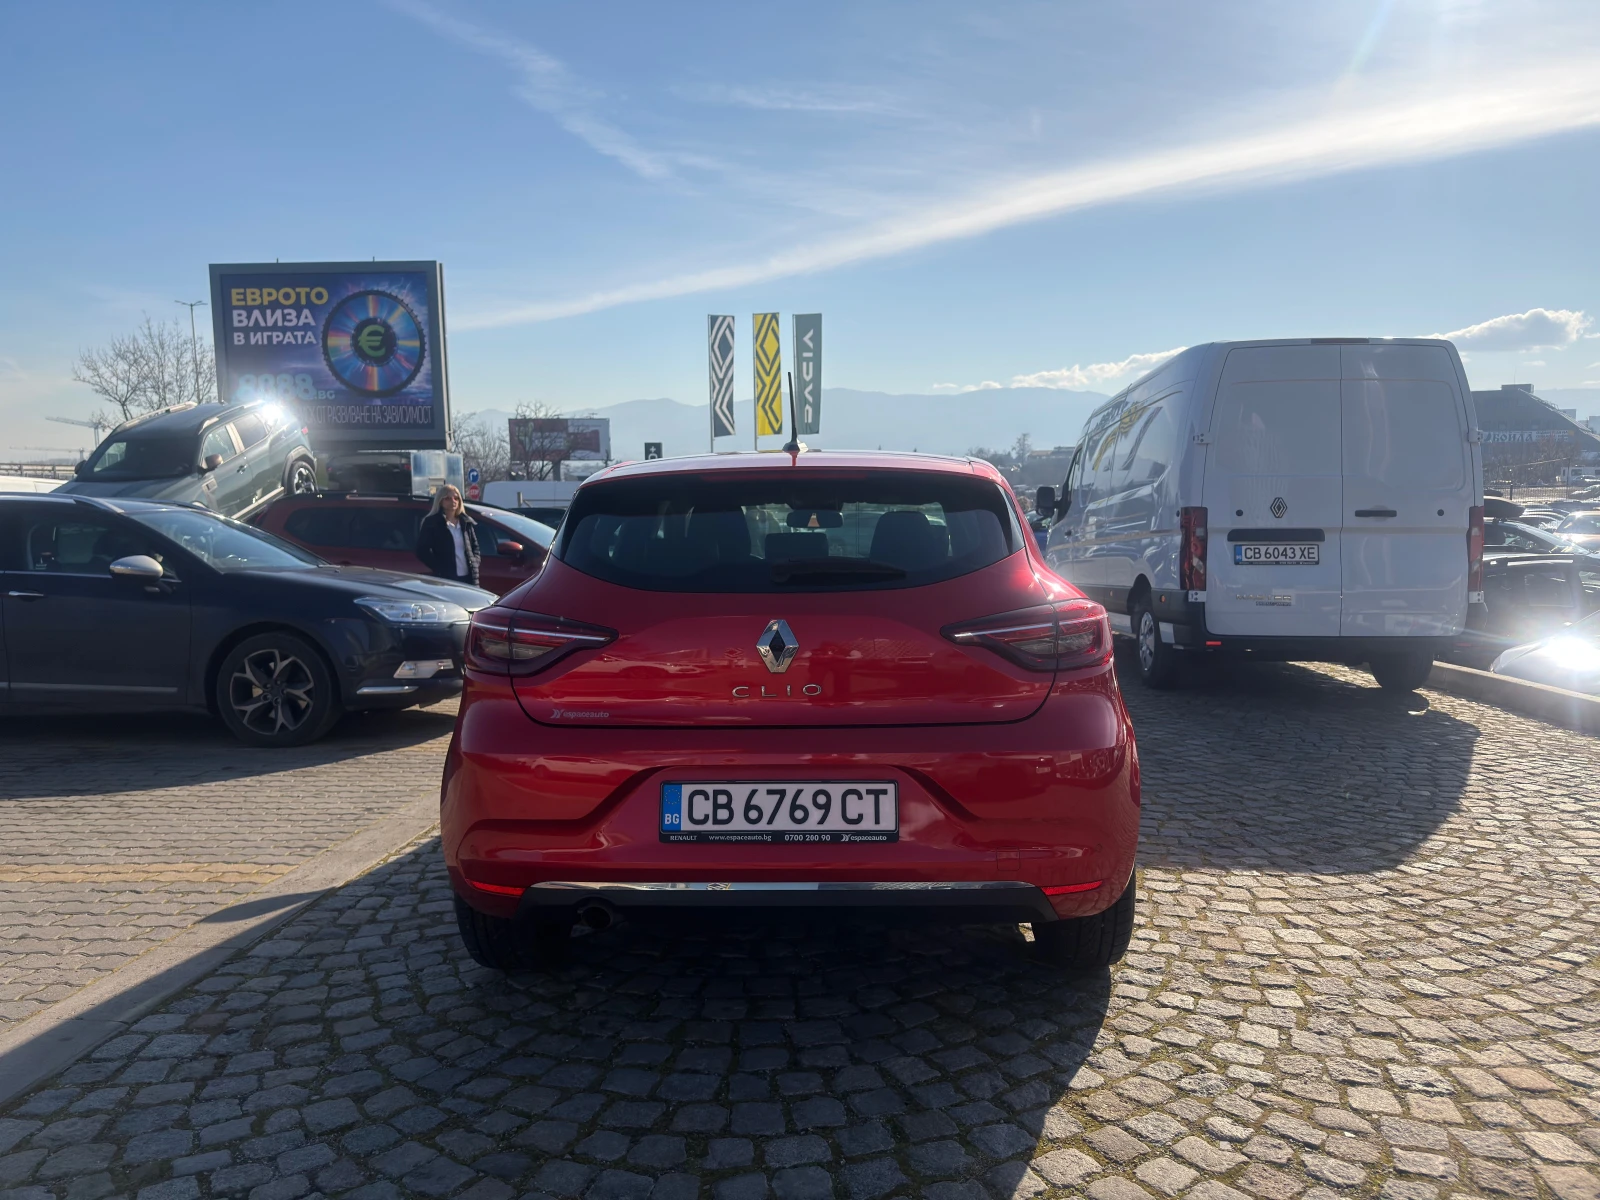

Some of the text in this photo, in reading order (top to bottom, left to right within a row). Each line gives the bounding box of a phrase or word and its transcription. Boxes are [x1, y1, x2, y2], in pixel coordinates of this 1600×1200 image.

[230, 286, 329, 306] ЕВРОТО
[232, 308, 316, 327] ВЛИЗА
[233, 331, 317, 345] В ИГРАТА
[328, 406, 370, 424] РАЗВИВАНЕ
[372, 406, 382, 423] НА
[383, 405, 432, 424] ЗАВИСИМОСТ
[1244, 547, 1316, 560] CB 6043 XE
[731, 684, 822, 698] CLIO
[563, 709, 609, 719] espaceauto
[687, 788, 888, 826] CB 6769 CT
[664, 813, 680, 825] BG
[708, 834, 772, 842] www.espaceauto.bg
[850, 835, 888, 843] espaceauto
